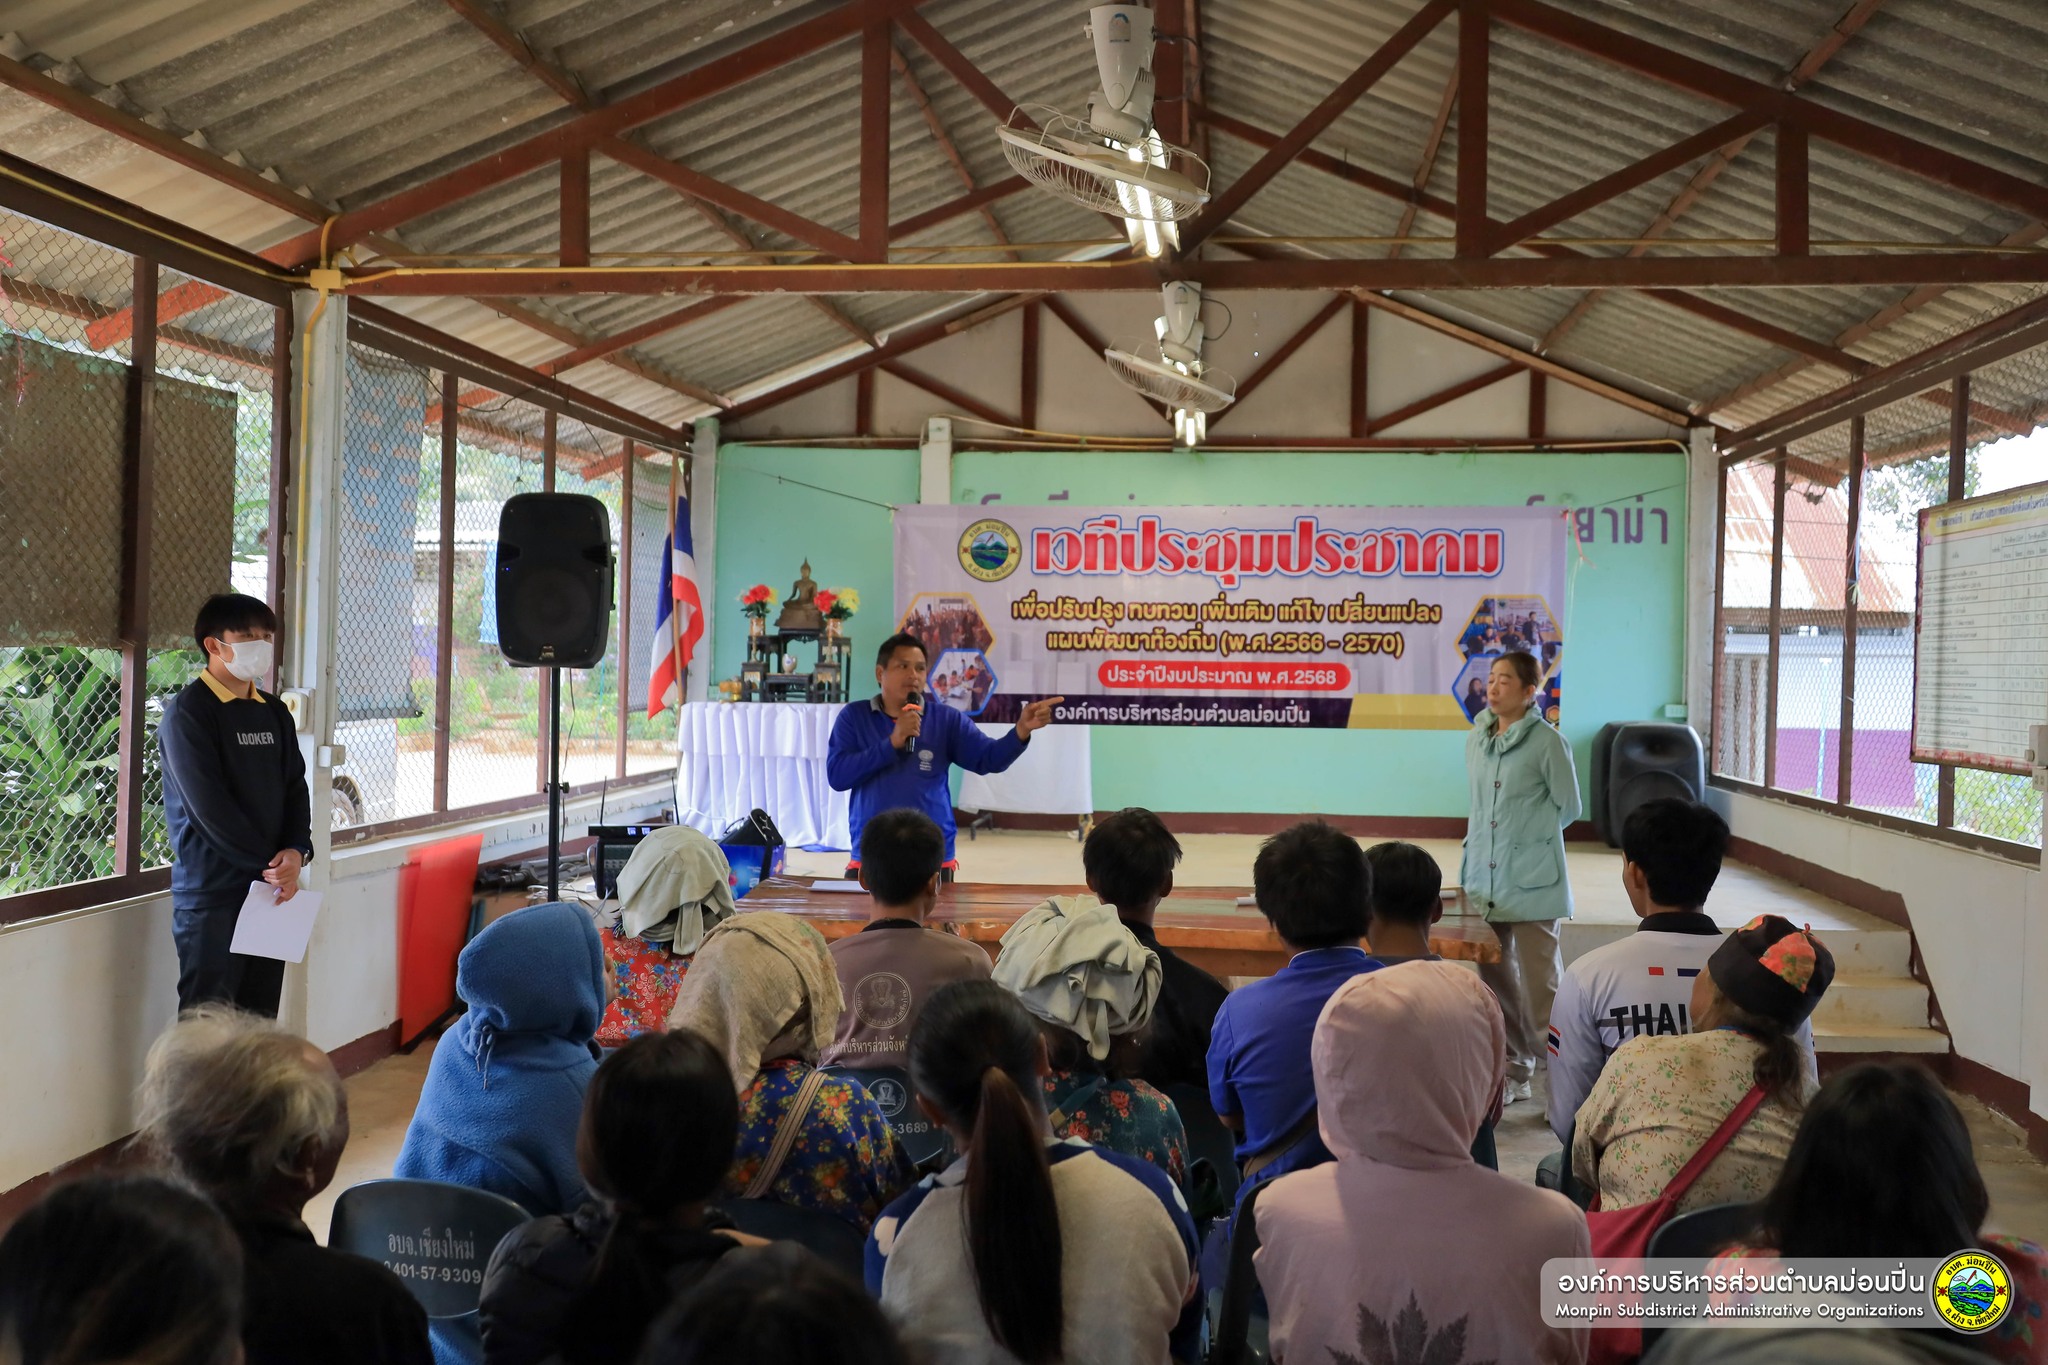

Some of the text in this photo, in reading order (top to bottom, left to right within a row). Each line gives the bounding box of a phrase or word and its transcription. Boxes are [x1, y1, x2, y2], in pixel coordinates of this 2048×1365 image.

[1034, 517, 1501, 587] เวทีประชุมประชาคม
[1011, 589, 1442, 627] เพื่อปรับปรุง ทบทวน เพิ่มเติม แก้ไข เปลี่ยนแปลง
[1047, 622, 1216, 651] แผนพัฒนาท้องถิ่น
[1107, 664, 1336, 685] ประจำปีงบประมาณ พ.ศ.2568
[1055, 700, 1310, 723] องค์การบริหารส่วนตำบลม่อนปิ่น
[236, 732, 275, 745] LOOKER
[388, 1227, 475, 1260] อบจ.เชียงใหม่
